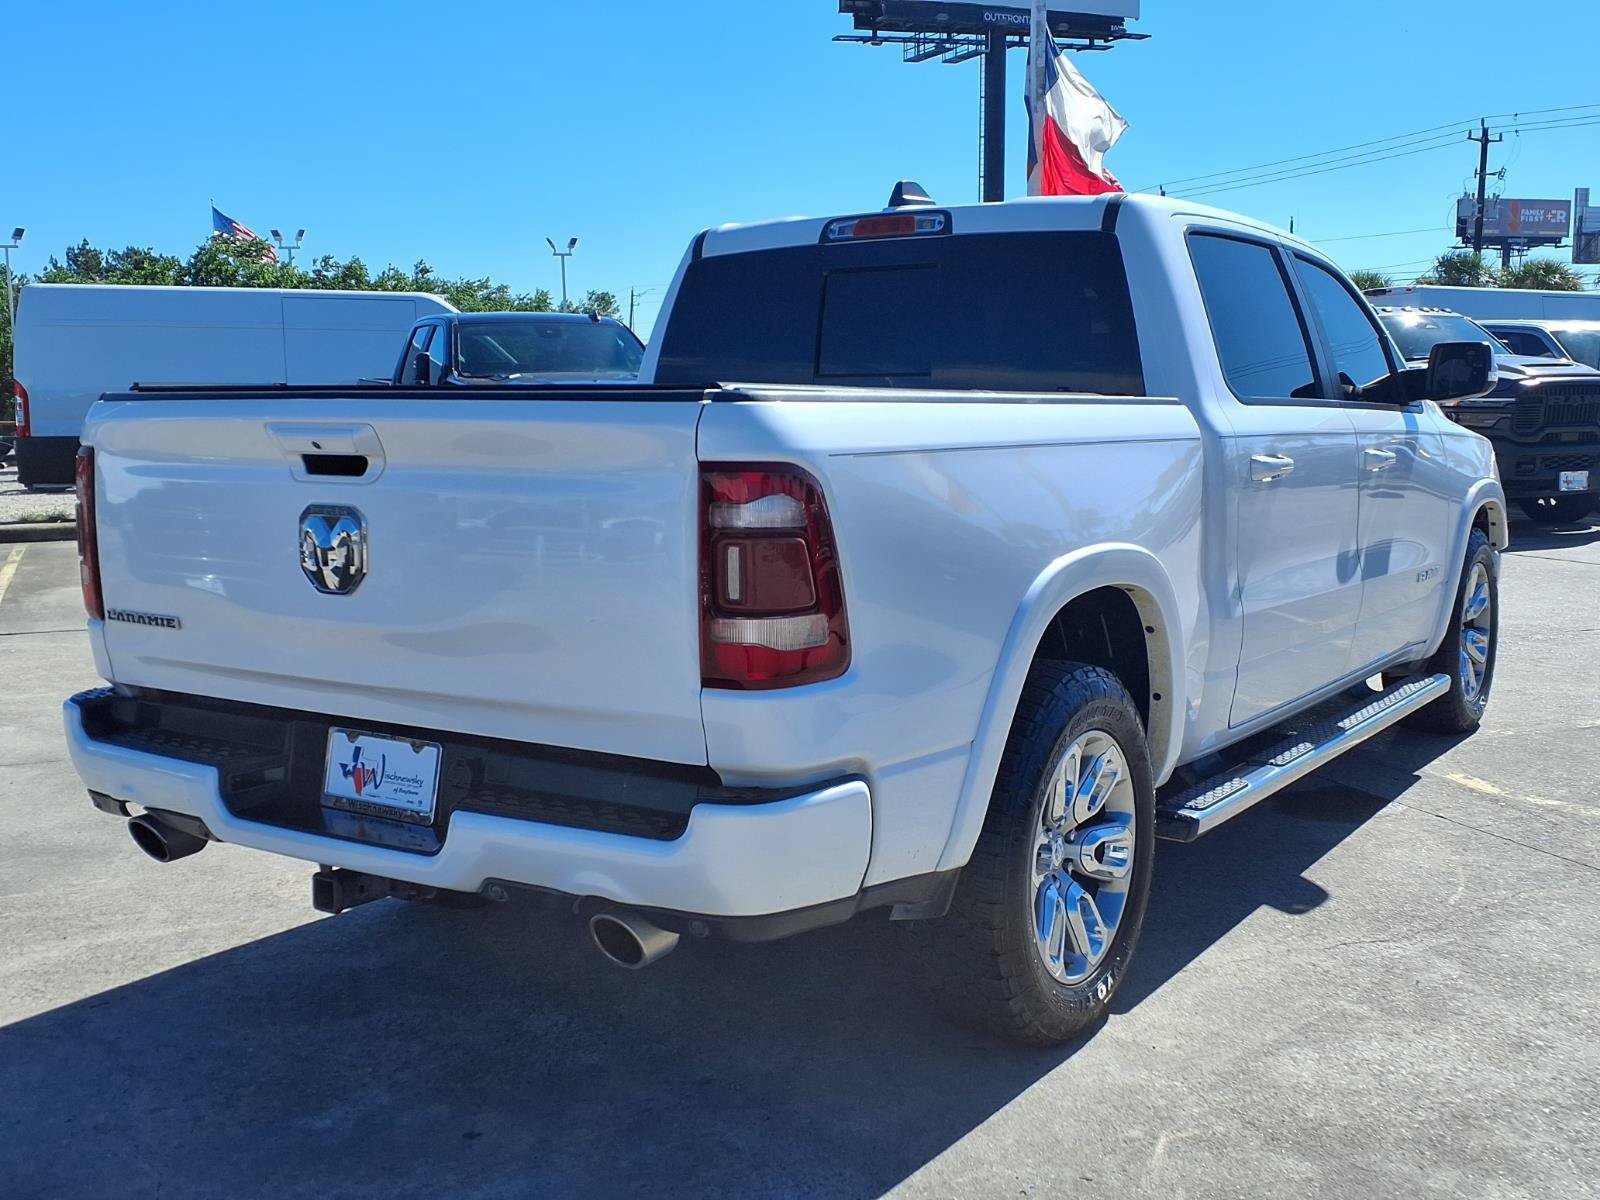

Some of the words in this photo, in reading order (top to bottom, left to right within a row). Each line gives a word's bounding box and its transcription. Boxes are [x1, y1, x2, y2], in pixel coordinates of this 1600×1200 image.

[984, 12, 1031, 24] OUTFRONT
[1520, 208, 1545, 216] FAMILY
[107, 608, 176, 629] LARAMIE
